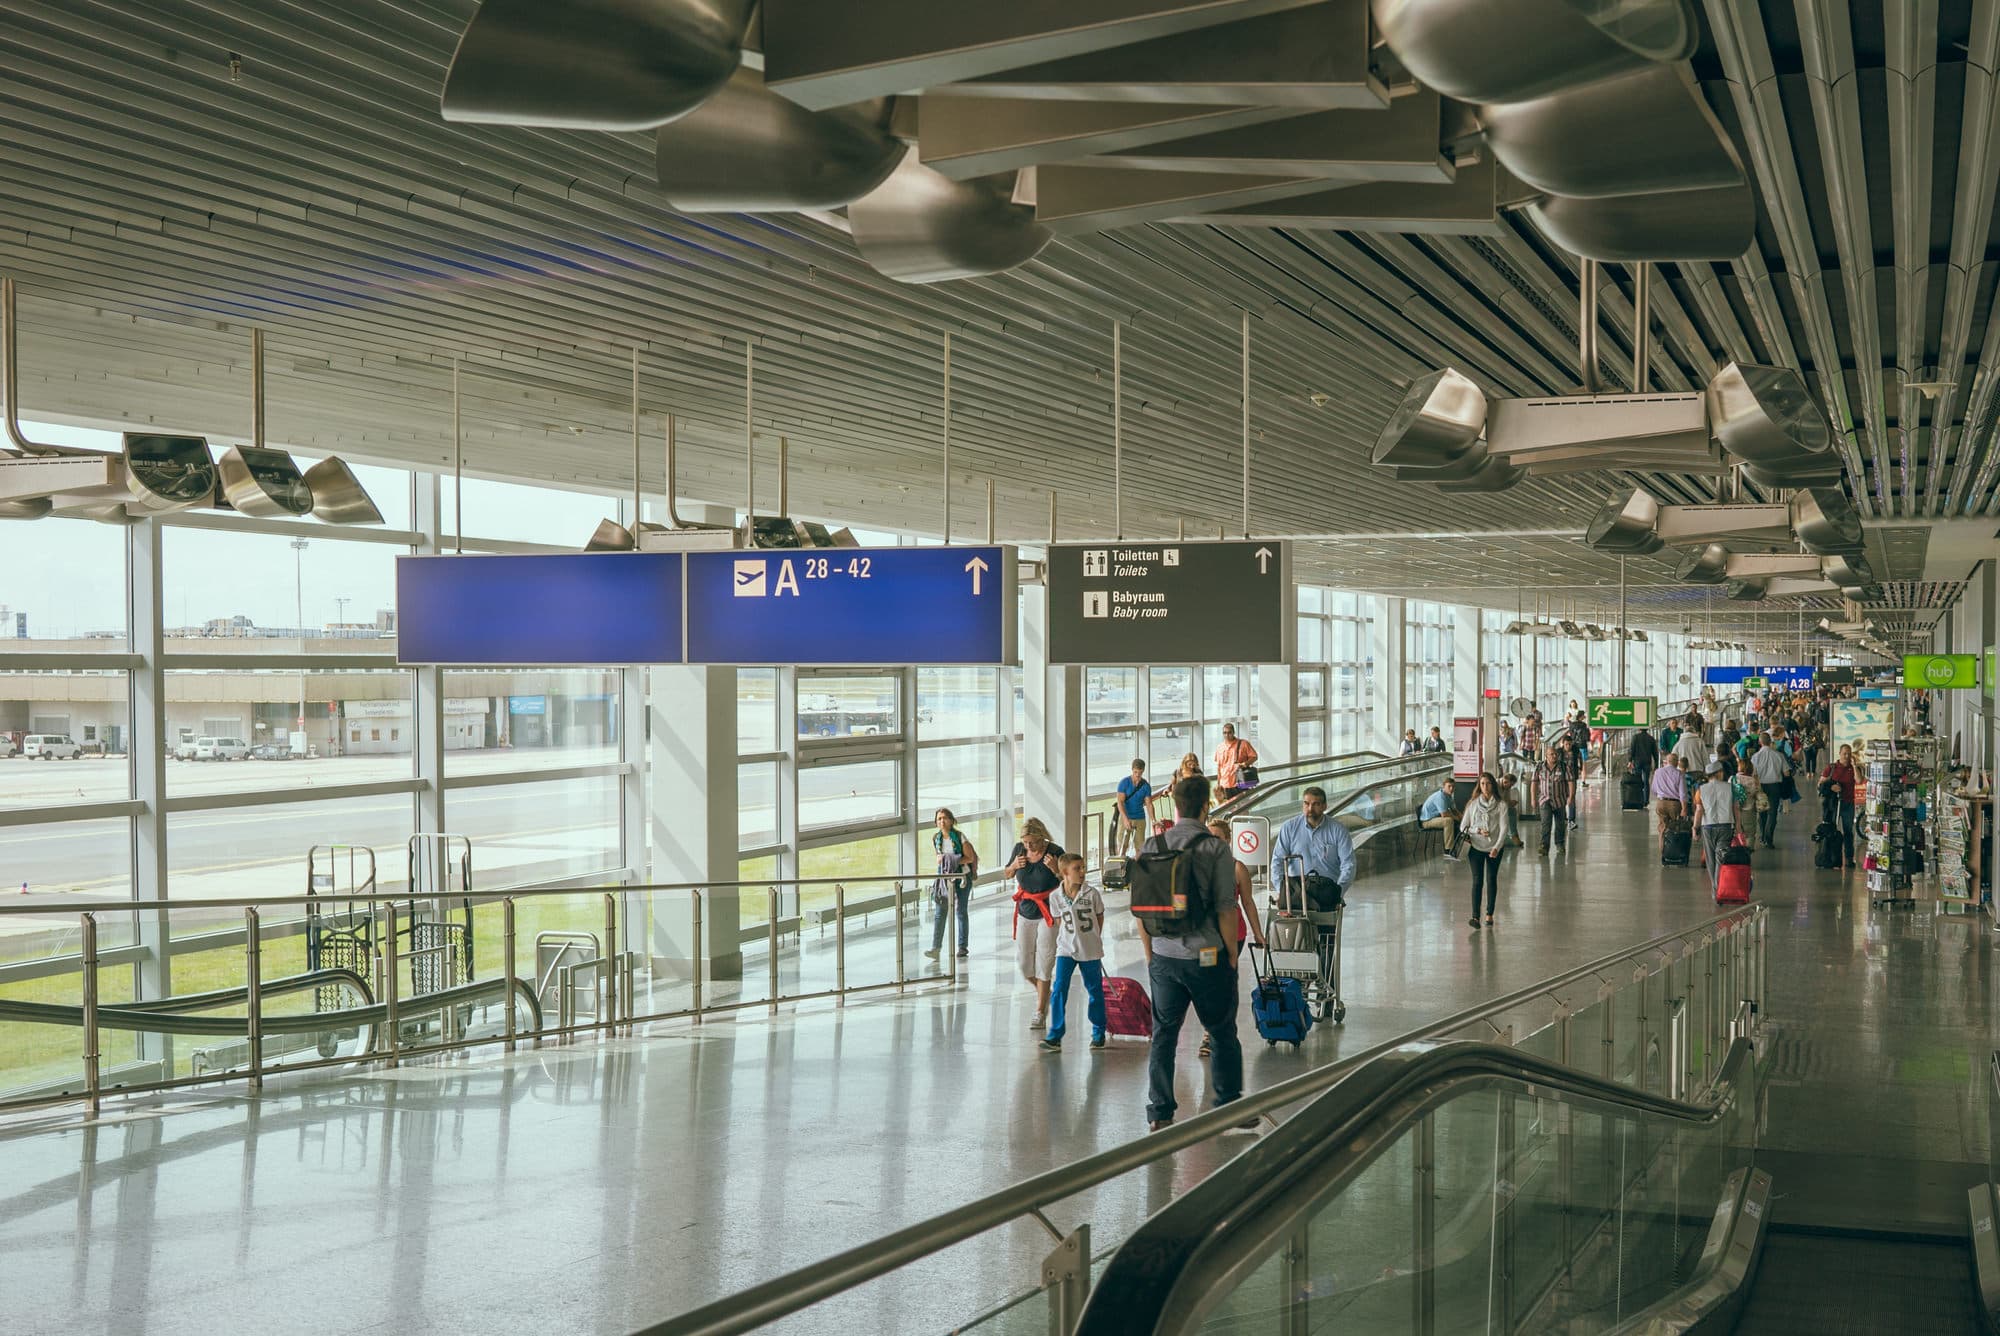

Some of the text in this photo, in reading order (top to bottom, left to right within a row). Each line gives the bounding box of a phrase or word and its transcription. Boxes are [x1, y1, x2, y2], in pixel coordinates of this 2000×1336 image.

[1112, 550, 1159, 561] Toiletten
[1113, 565, 1148, 577] Toilets
[774, 559, 800, 597] A
[1112, 591, 1165, 605] Babyraum
[1112, 606, 1168, 620] Baby room
[1928, 665, 1953, 678] hub
